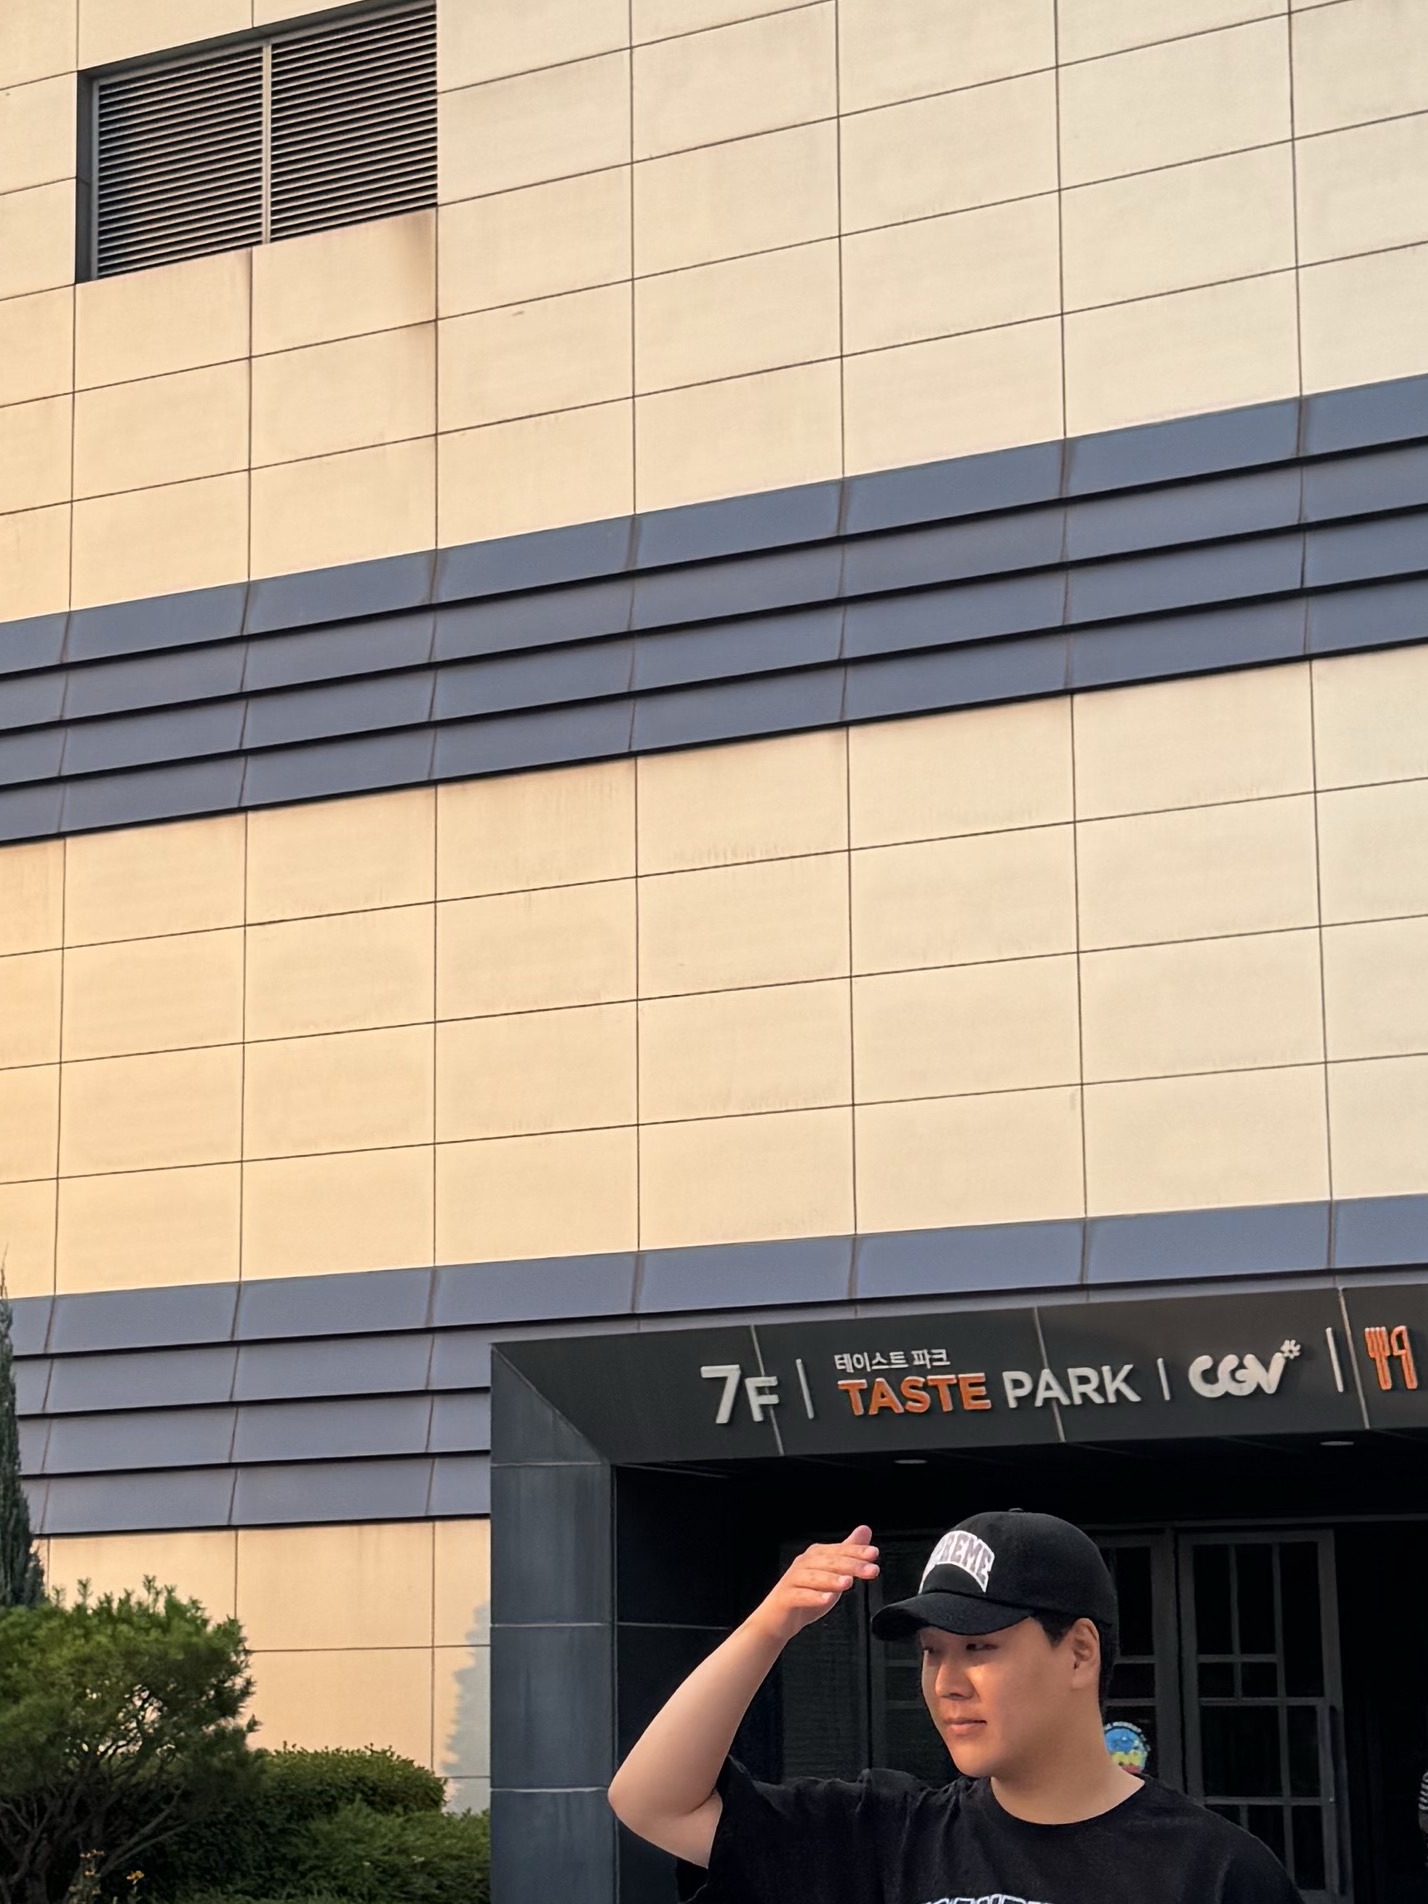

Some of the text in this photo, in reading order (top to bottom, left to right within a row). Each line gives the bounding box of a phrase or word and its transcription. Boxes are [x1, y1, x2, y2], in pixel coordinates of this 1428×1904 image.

[834, 1349, 951, 1373] 테이스트 파크
[700, 1352, 1286, 1424] 7F TASTE PARK CGV
